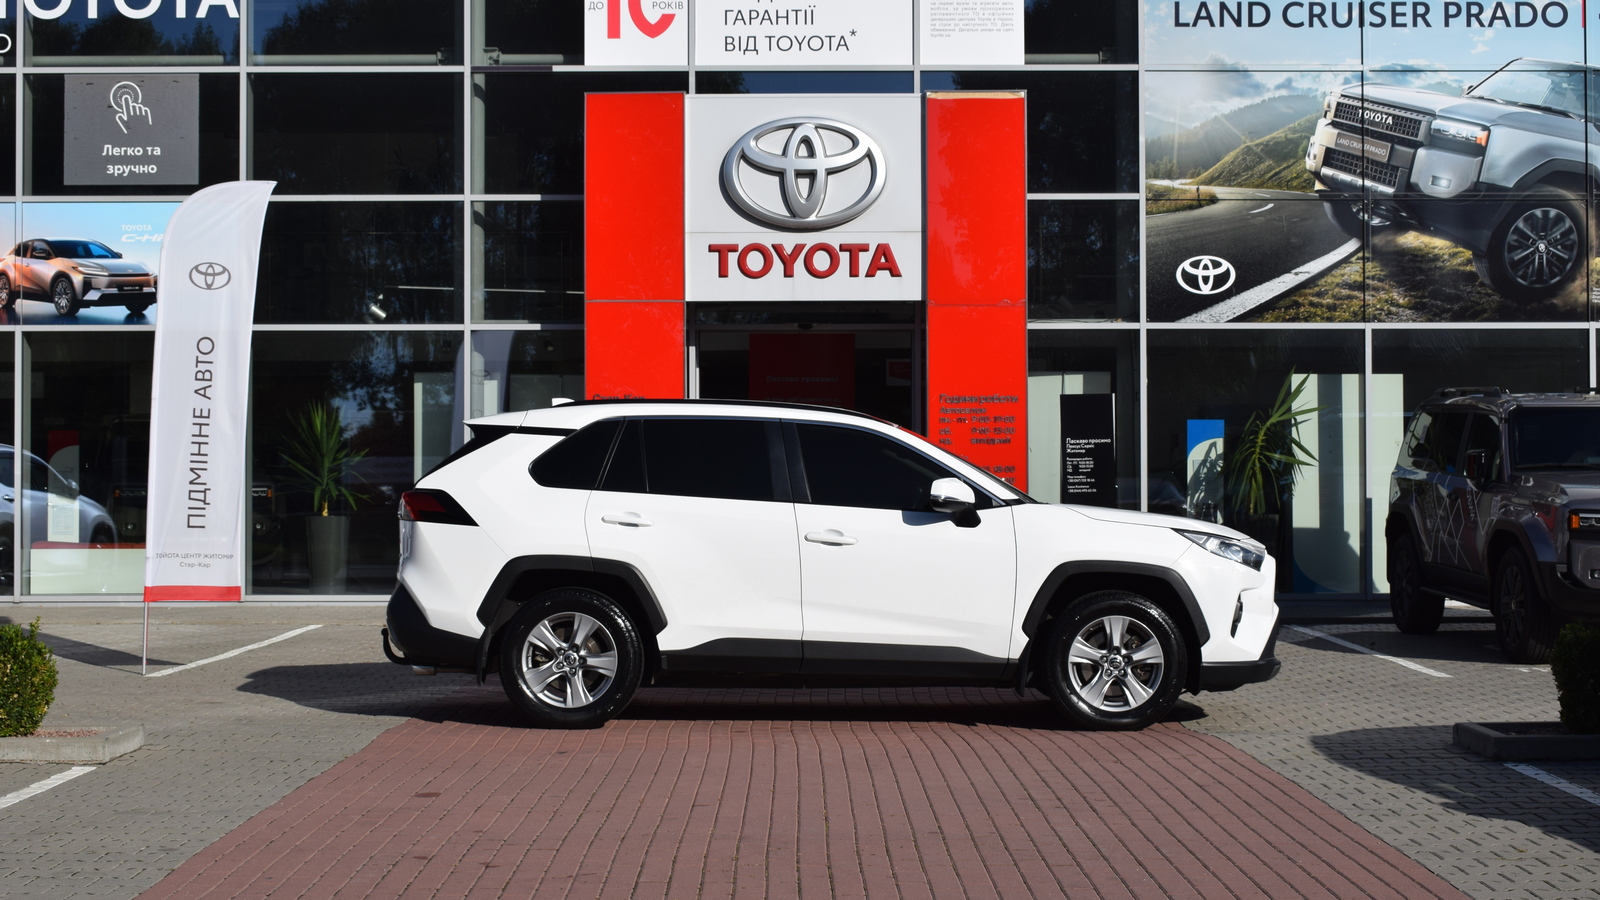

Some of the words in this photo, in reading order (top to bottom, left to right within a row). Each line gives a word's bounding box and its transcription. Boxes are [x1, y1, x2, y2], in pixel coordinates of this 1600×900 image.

[588, 1, 604, 11] ДО
[652, 1, 684, 10] РОКІВ
[724, 5, 816, 26] ГАРАНТІЇ
[1174, 1, 1271, 28] LAND
[1282, 1, 1433, 28] CRUISER
[1443, 1, 1569, 28] PRADO
[724, 35, 759, 55] ВІД
[1336, 137, 1350, 146] LAND
[102, 144, 143, 156] Легко
[146, 146, 161, 156] та
[106, 164, 158, 177] зручно
[708, 242, 903, 279] TOYOTA
[194, 336, 215, 400] АВТО
[940, 393, 978, 405] Години
[979, 393, 1018, 406] роботи
[940, 406, 987, 414] Автосалон
[939, 427, 952, 435] сб.
[971, 436, 1012, 445] вихідний
[187, 407, 211, 529] ПІДМІННЕ
[156, 551, 180, 559] ТОЙОТА
[181, 552, 202, 560] ЦЕНТР
